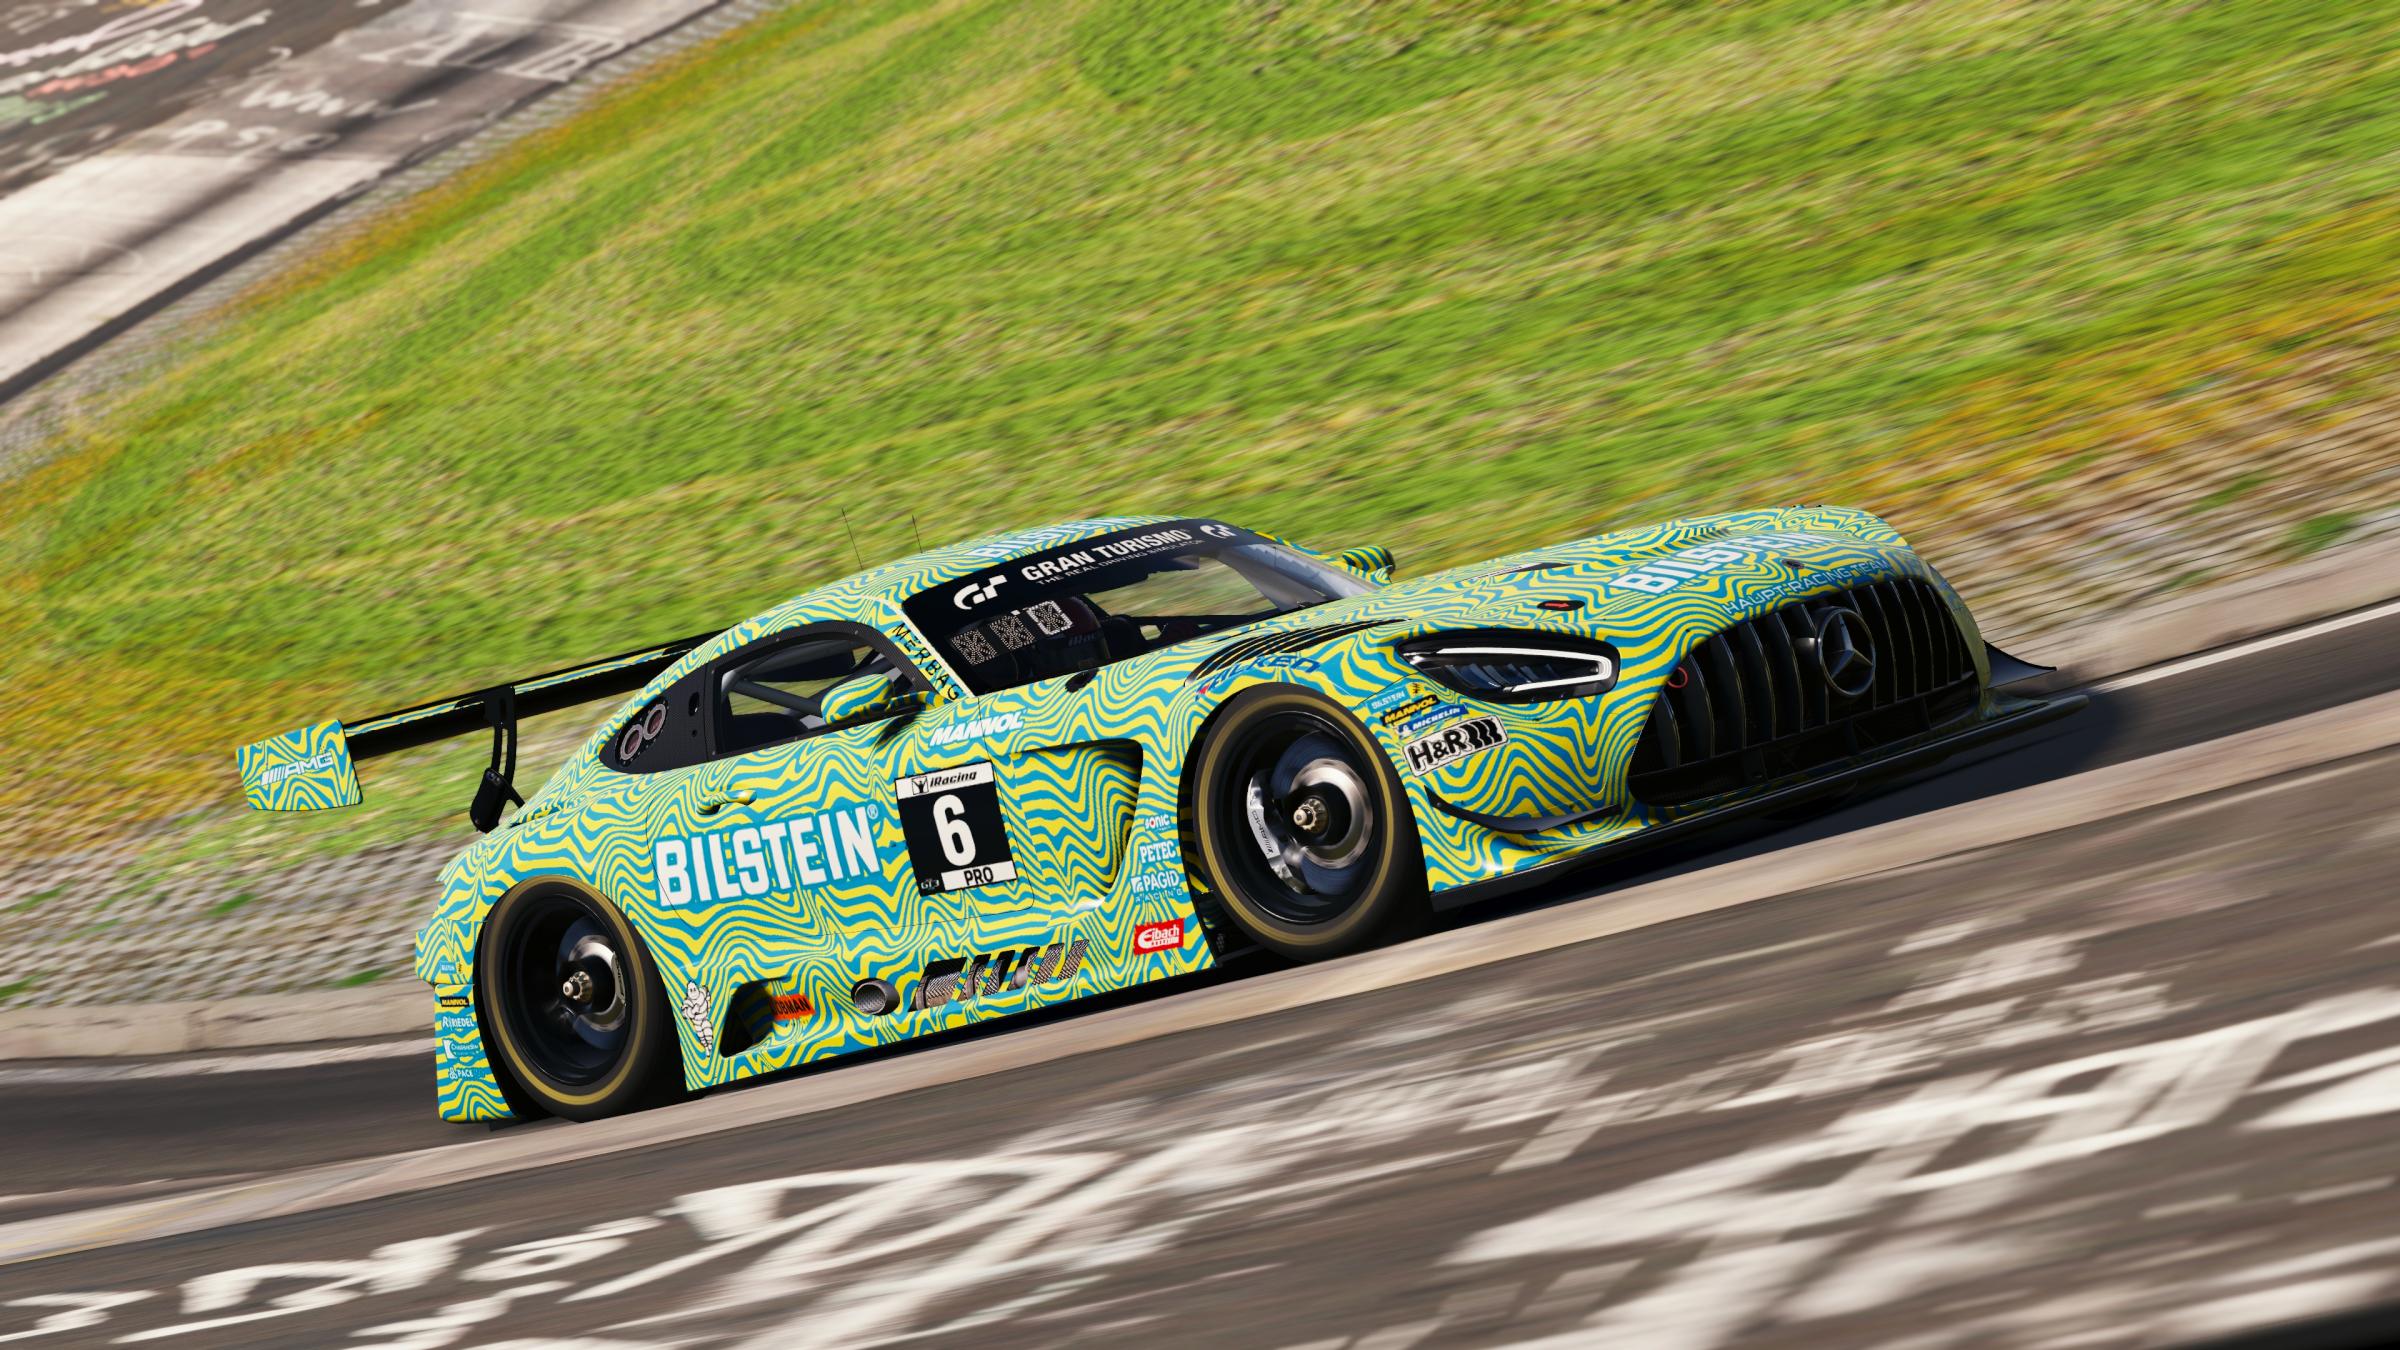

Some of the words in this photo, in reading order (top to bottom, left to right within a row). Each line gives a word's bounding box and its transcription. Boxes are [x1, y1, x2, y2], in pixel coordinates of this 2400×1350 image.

[1021, 551, 1096, 581] GRAN
[1092, 529, 1193, 559] TURISMO
[1036, 574, 1065, 586] THE
[1067, 565, 1100, 577] REAL
[1099, 551, 1147, 567] DRIVING
[1149, 539, 1205, 557] SIMULATOR
[1607, 532, 1826, 594] BILSTEIN
[1722, 584, 1788, 614] HAUPT
[1788, 567, 1851, 592] RACING
[1851, 558, 1891, 577] TEAM
[891, 622, 960, 701] MERBAG
[929, 711, 1025, 747] MANNOL
[1384, 697, 1437, 724] MANNOL
[1412, 707, 1461, 731] MICHELIN
[1408, 729, 1468, 770] H&R
[930, 771, 978, 788] iRacing
[932, 794, 977, 867] 6
[655, 805, 881, 907] BILSTEIN
[1140, 840, 1177, 864] PETEC
[963, 866, 994, 886] PRO
[1142, 869, 1180, 892] PAGID
[1137, 924, 1180, 949] Eibach
